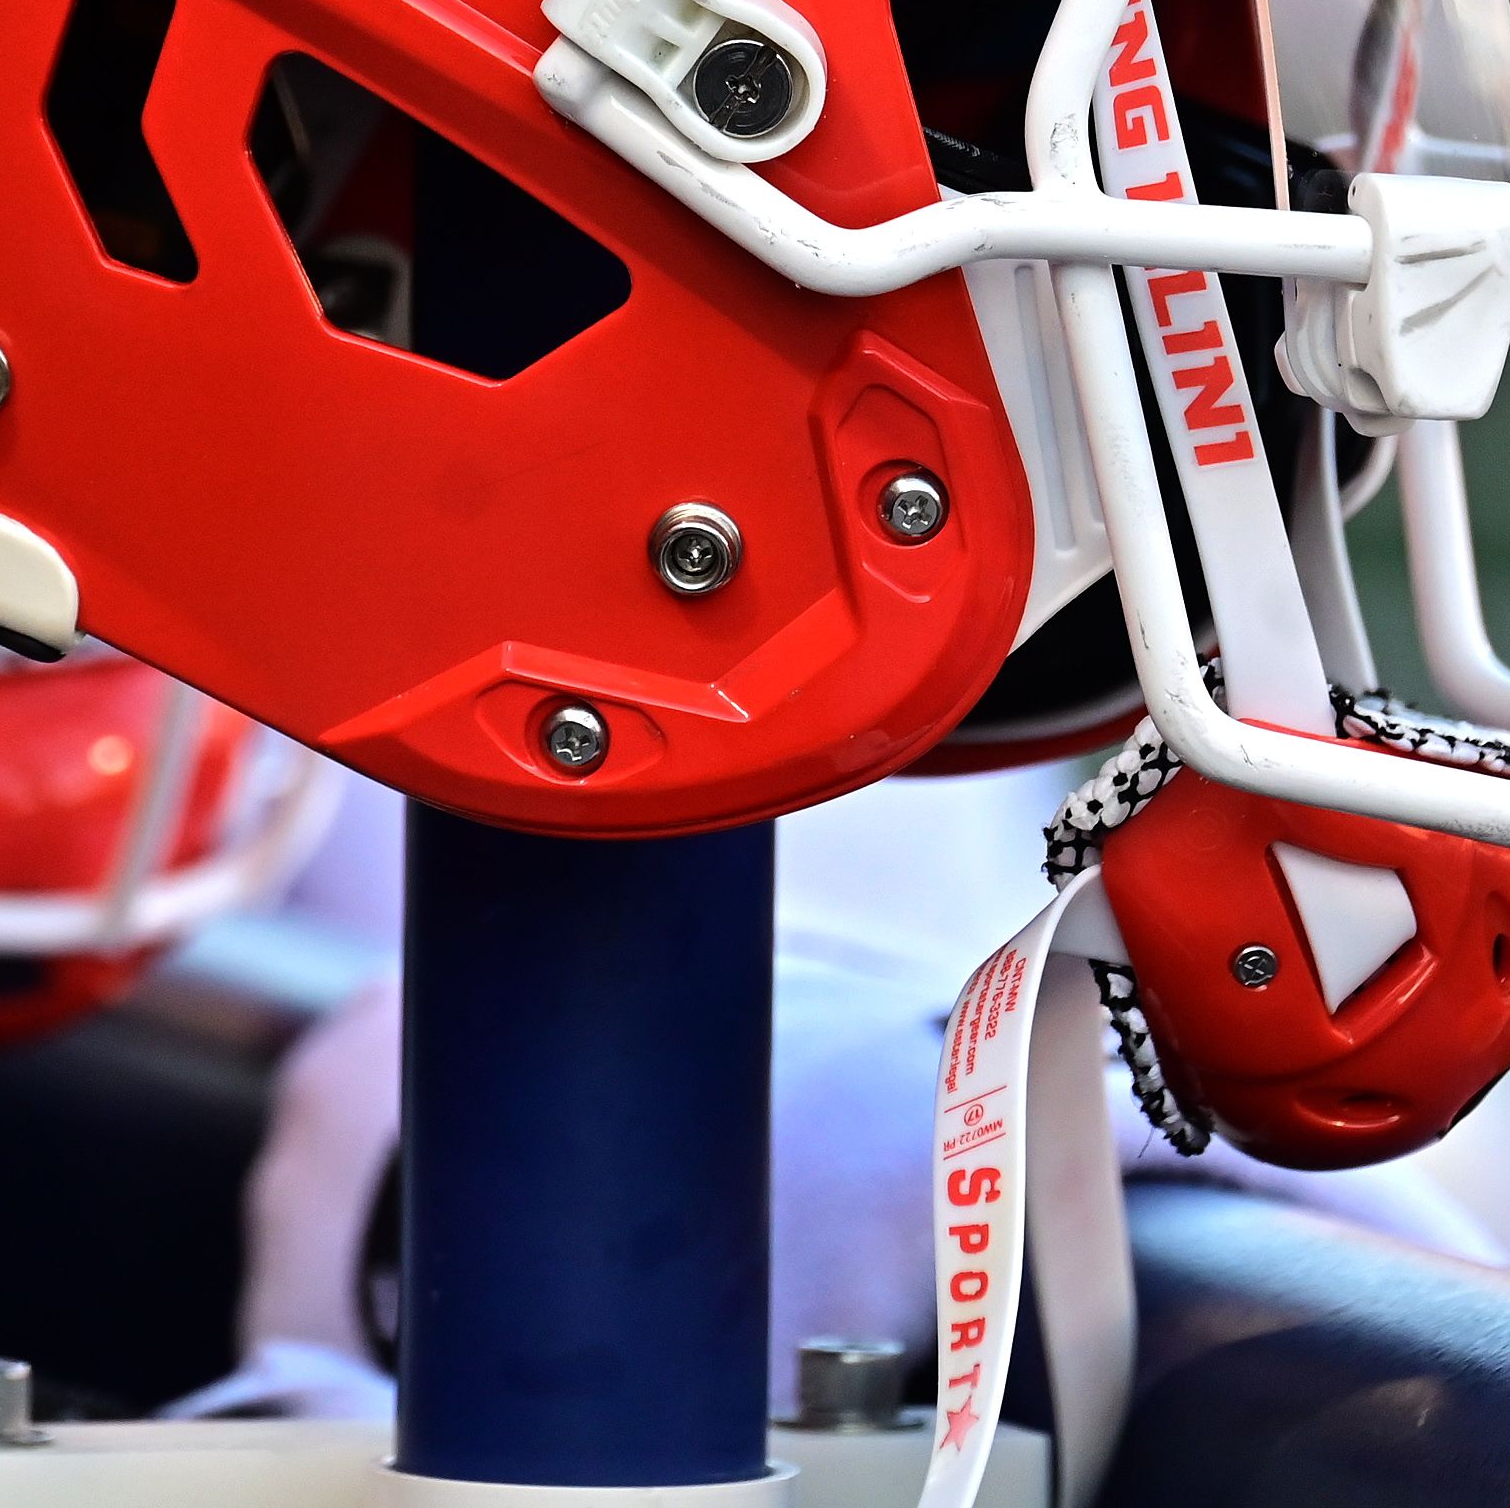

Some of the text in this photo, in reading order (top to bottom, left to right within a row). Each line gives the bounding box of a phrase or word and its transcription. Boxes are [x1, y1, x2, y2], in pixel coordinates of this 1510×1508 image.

[1124, 171, 1255, 467] ILINI
[985, 949, 1017, 1040] 888-776-3322
[1004, 957, 1027, 1012] CNT-MW
[947, 1167, 1002, 1389] SPORT
